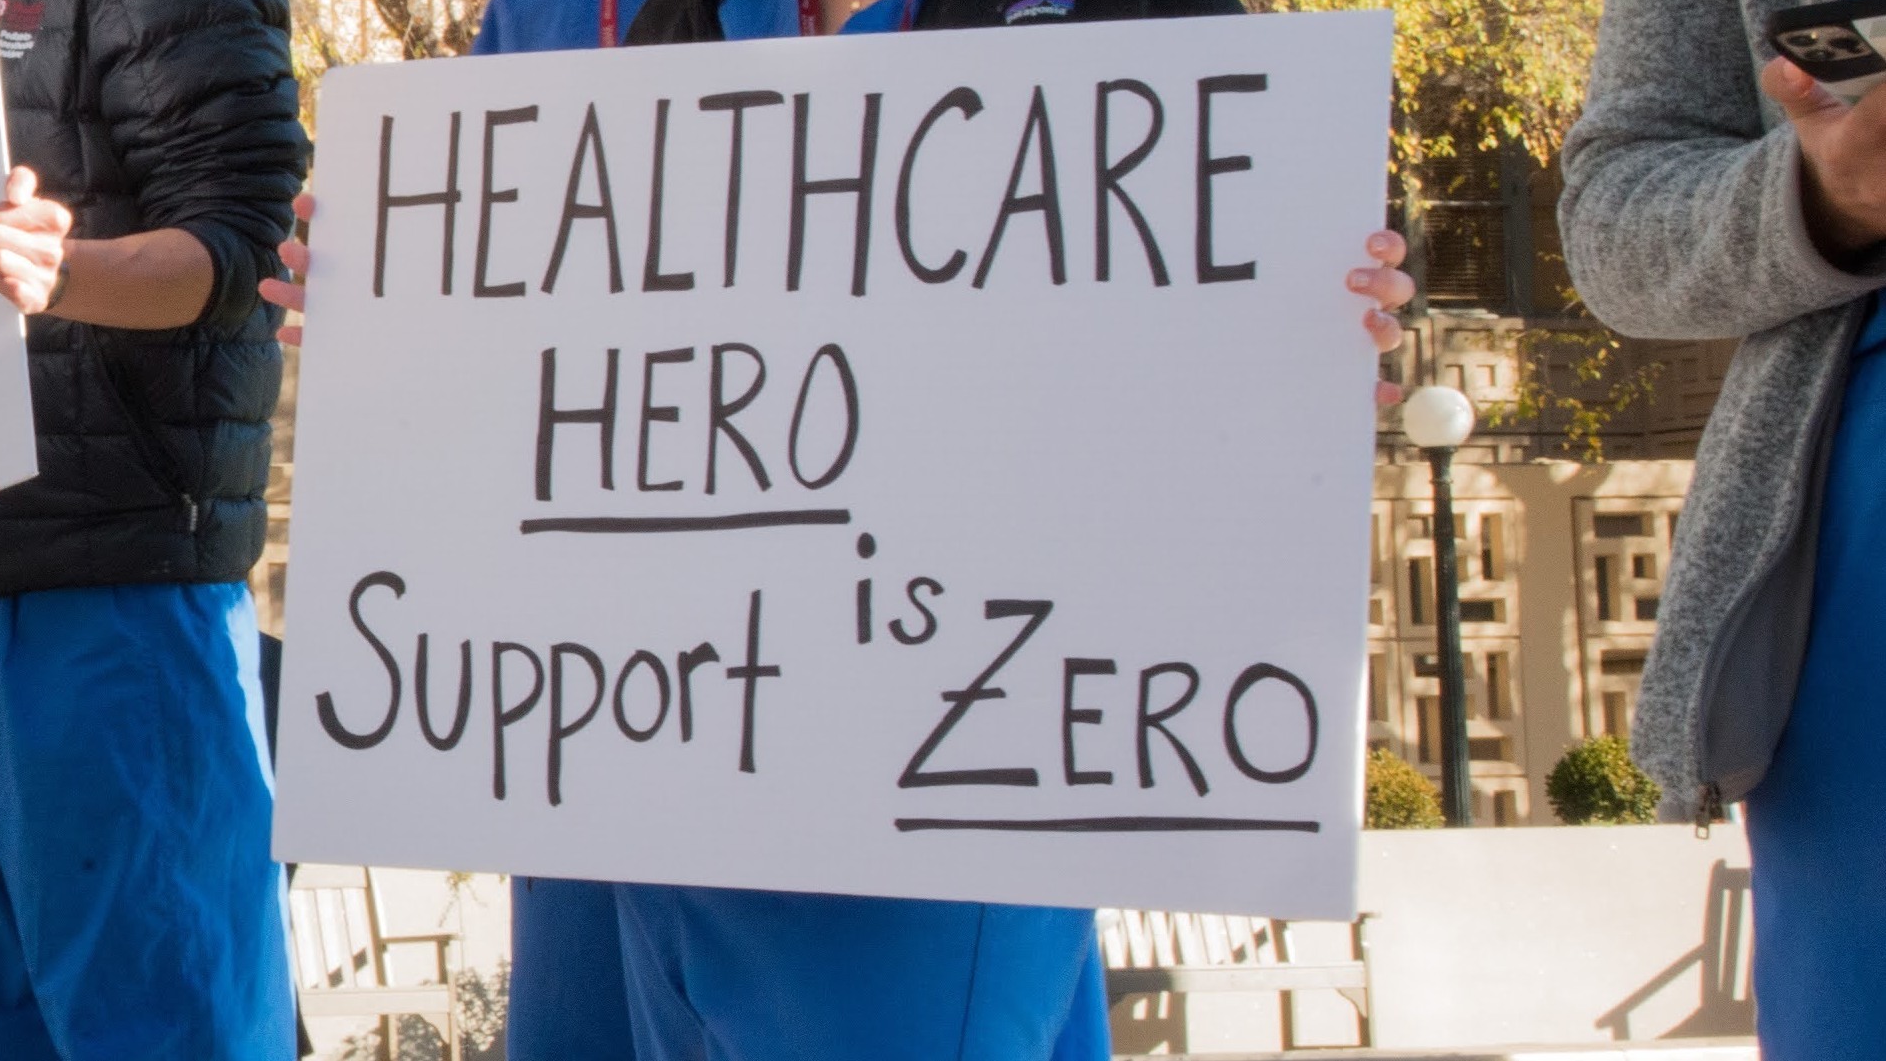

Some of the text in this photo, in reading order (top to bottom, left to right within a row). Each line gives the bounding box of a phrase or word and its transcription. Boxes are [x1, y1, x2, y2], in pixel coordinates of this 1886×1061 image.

[372, 73, 1267, 298] HEALTHCARE
[533, 342, 860, 502] HERO
[315, 531, 1318, 807] Support is ZERO
